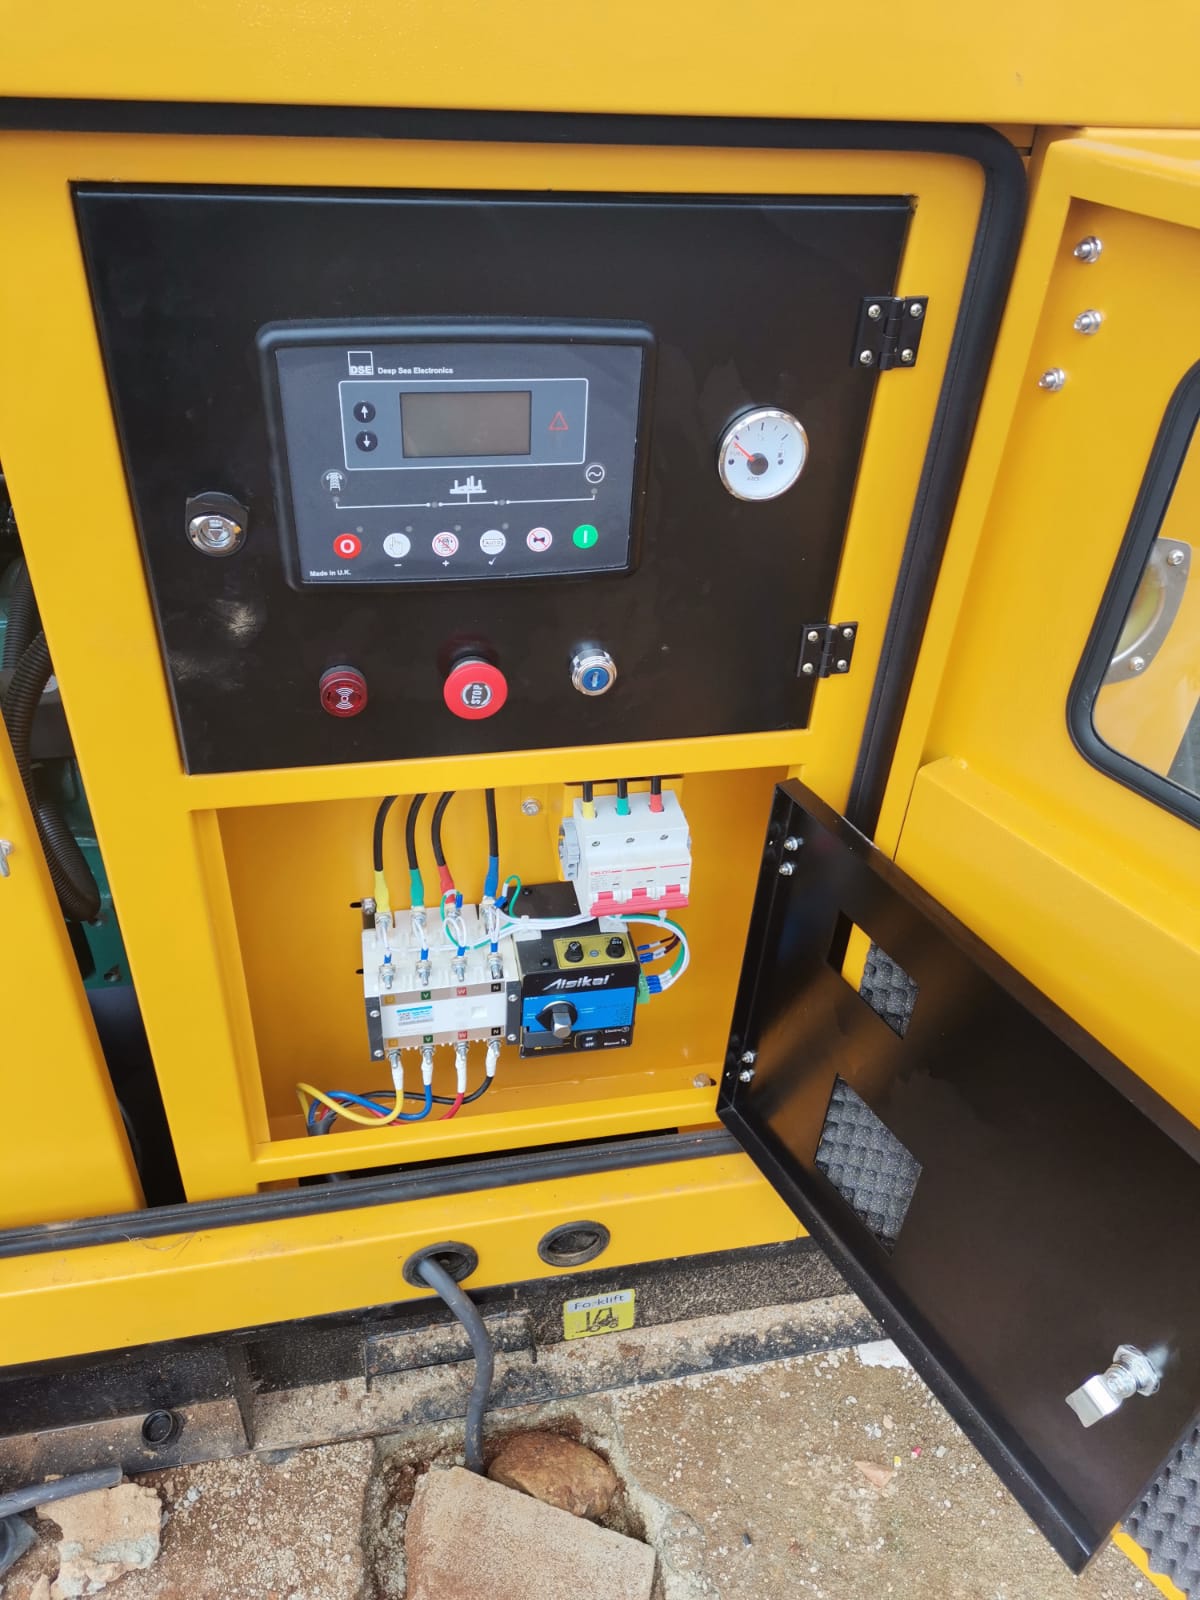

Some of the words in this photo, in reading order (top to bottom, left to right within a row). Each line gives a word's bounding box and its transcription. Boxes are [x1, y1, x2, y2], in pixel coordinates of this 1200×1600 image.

[350, 365, 372, 375] DSE
[377, 367, 397, 375] Deep
[413, 366, 454, 375] Electronics
[471, 684, 483, 705] STOP
